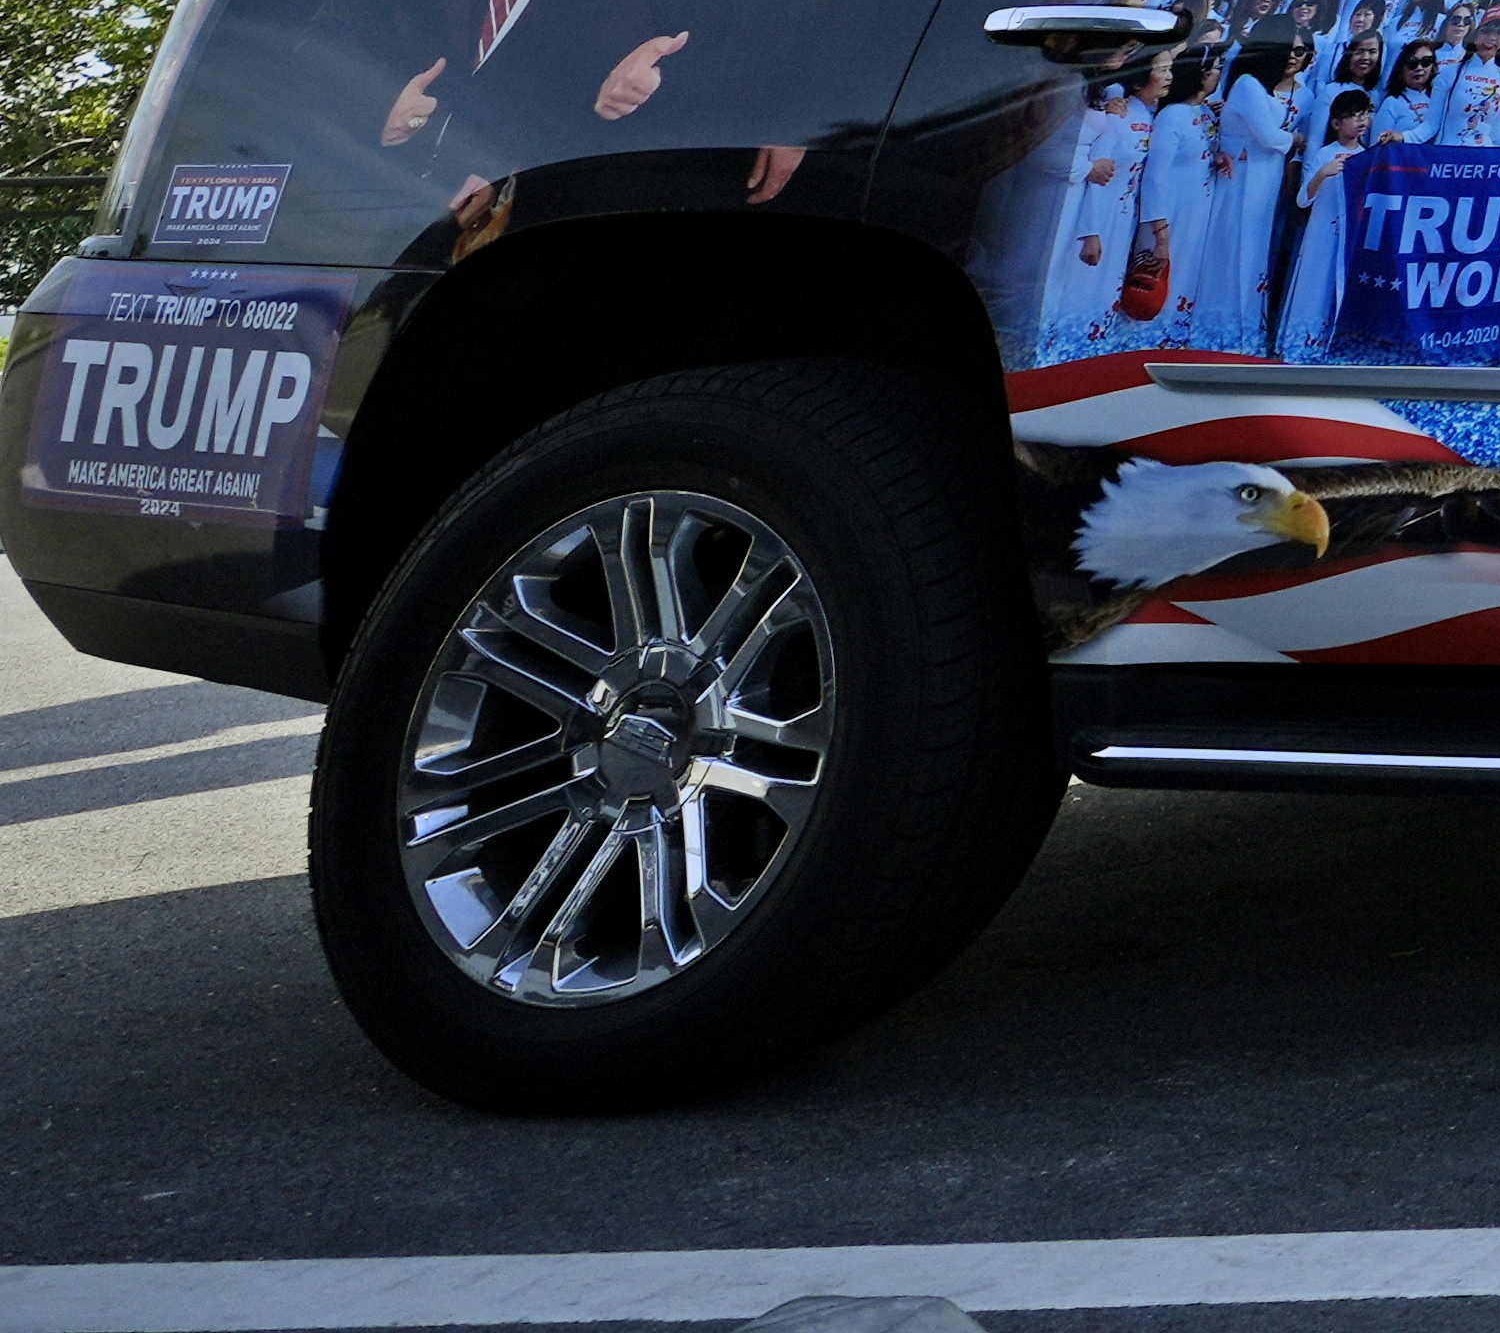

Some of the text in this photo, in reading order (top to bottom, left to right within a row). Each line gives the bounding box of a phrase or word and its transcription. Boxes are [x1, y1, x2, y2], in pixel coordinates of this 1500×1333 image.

[1429, 163, 1484, 179] NEVER
[170, 186, 277, 220] TRUMP
[106, 292, 299, 330] TEXT TRUMP TO 88022
[60, 339, 311, 457] TRUMP
[68, 460, 261, 498] MAKE AMERICA GREAT AGAIN!
[140, 498, 181, 517] 2024
